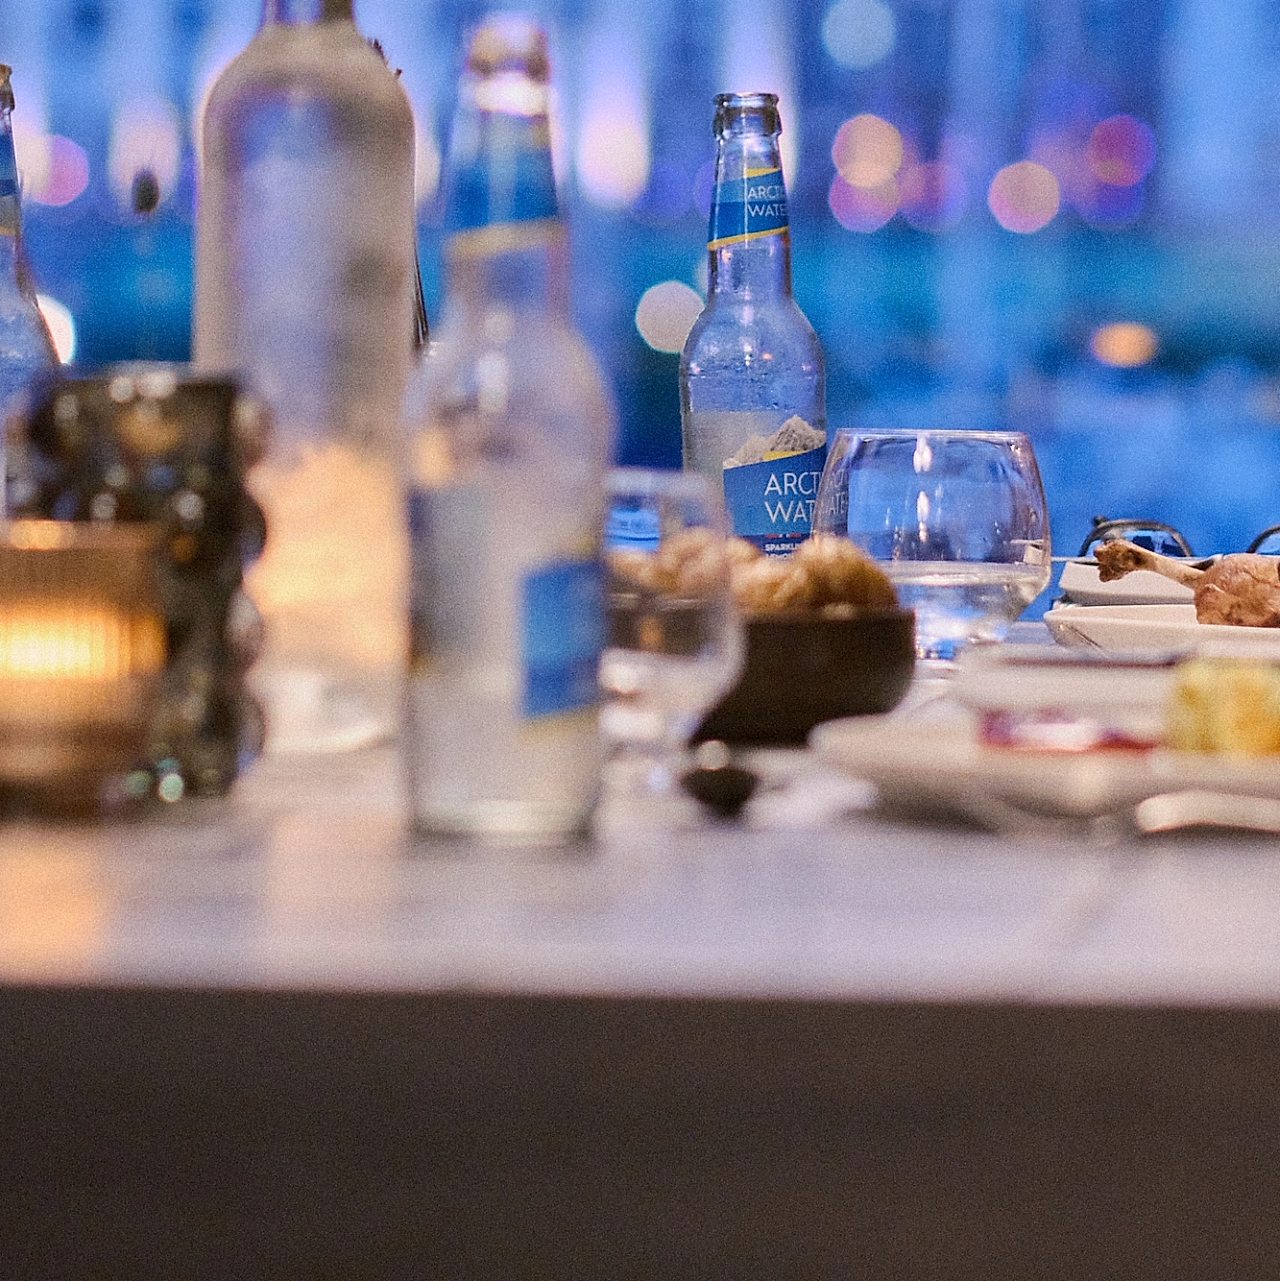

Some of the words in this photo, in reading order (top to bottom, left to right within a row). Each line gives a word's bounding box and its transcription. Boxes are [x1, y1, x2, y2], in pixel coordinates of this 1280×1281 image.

[747, 185, 784, 199] ARCT
[747, 203, 788, 217] WATE
[764, 472, 822, 495] ARCT
[764, 499, 817, 523] WAT
